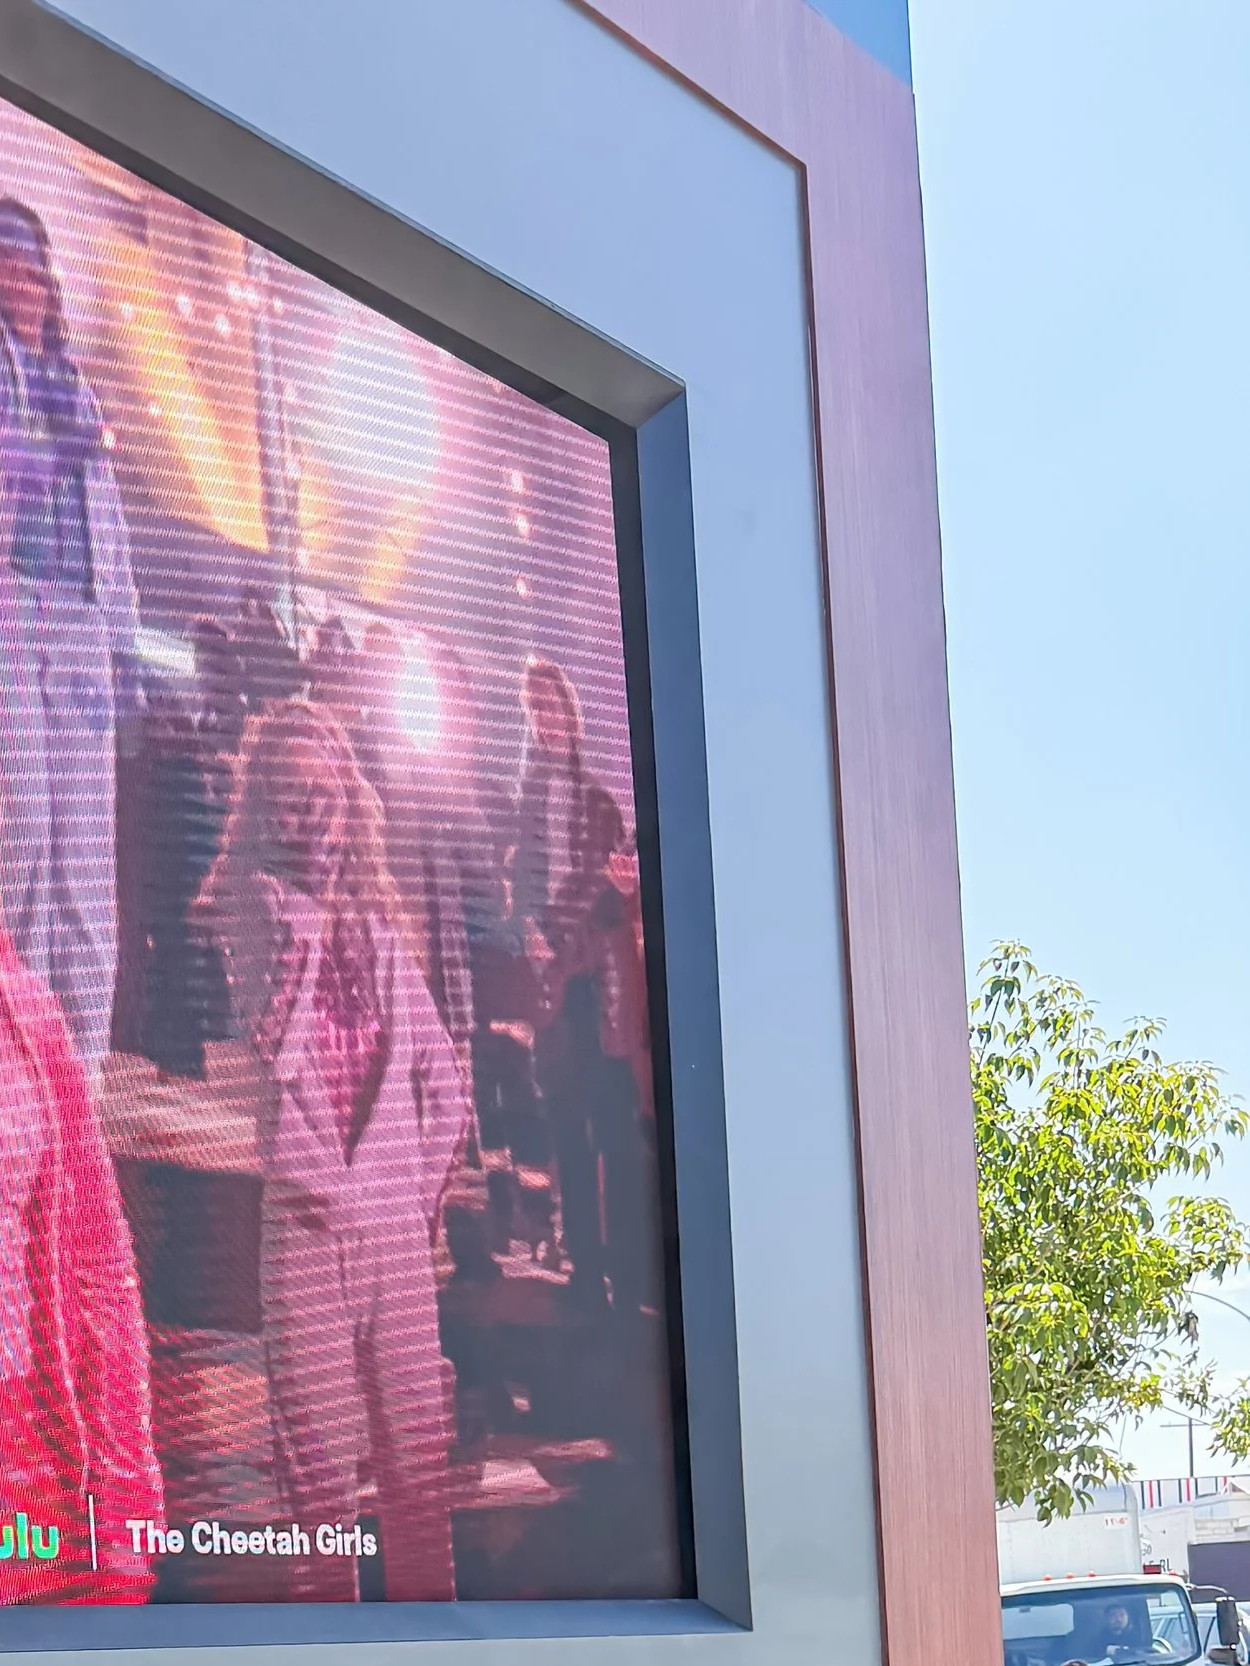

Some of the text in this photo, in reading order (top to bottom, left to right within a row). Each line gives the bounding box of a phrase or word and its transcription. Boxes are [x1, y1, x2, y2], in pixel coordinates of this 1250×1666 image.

[125, 1519, 185, 1554] The
[190, 1520, 311, 1556] Cheetah
[315, 1522, 378, 1557] Girls
